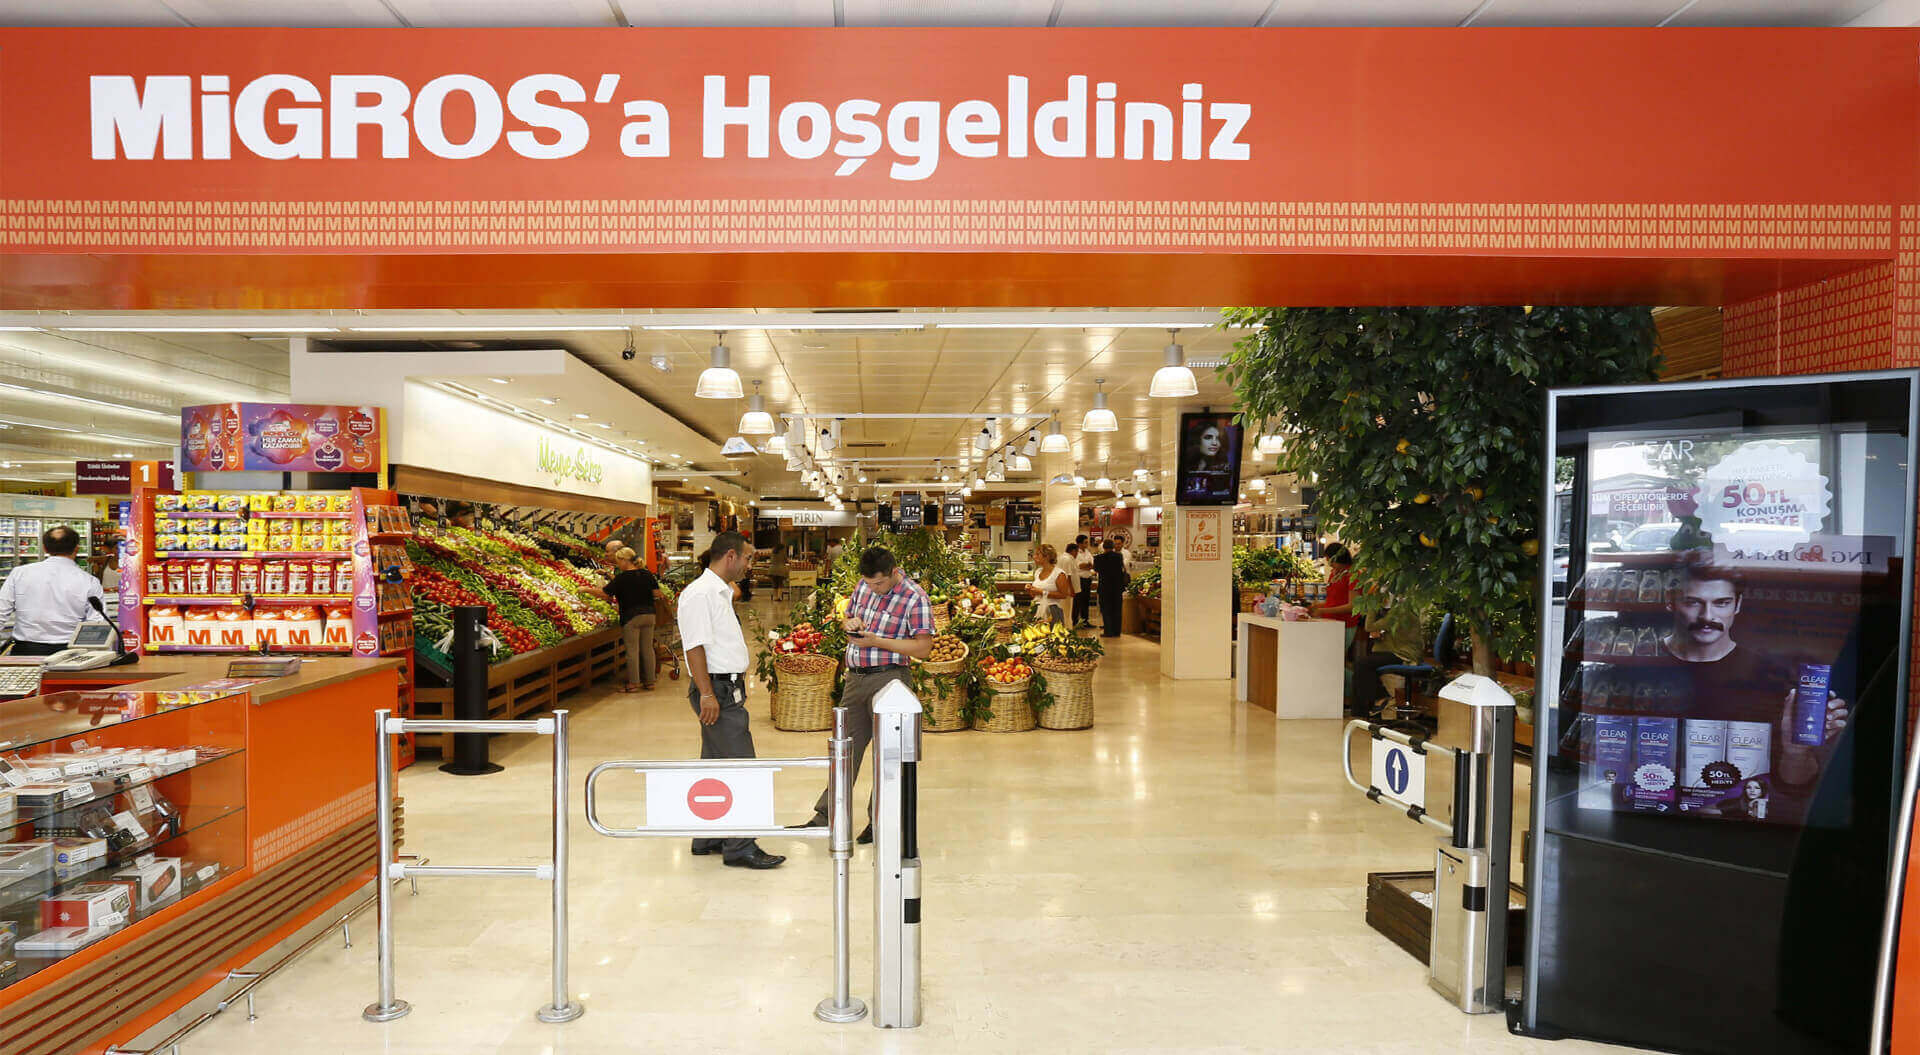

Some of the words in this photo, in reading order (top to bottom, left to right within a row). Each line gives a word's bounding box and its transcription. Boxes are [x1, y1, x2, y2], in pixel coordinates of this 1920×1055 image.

[702, 74, 1252, 182] Hoşgeldiniz
[139, 464, 150, 482] 1
[794, 512, 824, 523] FIRIN
[1190, 543, 1217, 553] TAZE
[152, 625, 175, 642] M
[188, 629, 211, 645] M
[221, 629, 244, 645] M
[256, 628, 277, 645] M
[288, 629, 310, 645] M
[327, 626, 348, 643] M
[1600, 729, 1628, 738] CLEAR
[1640, 732, 1669, 741] CLEAR
[1690, 734, 1721, 743] CLEAR
[1731, 736, 1762, 745] CLEAR
